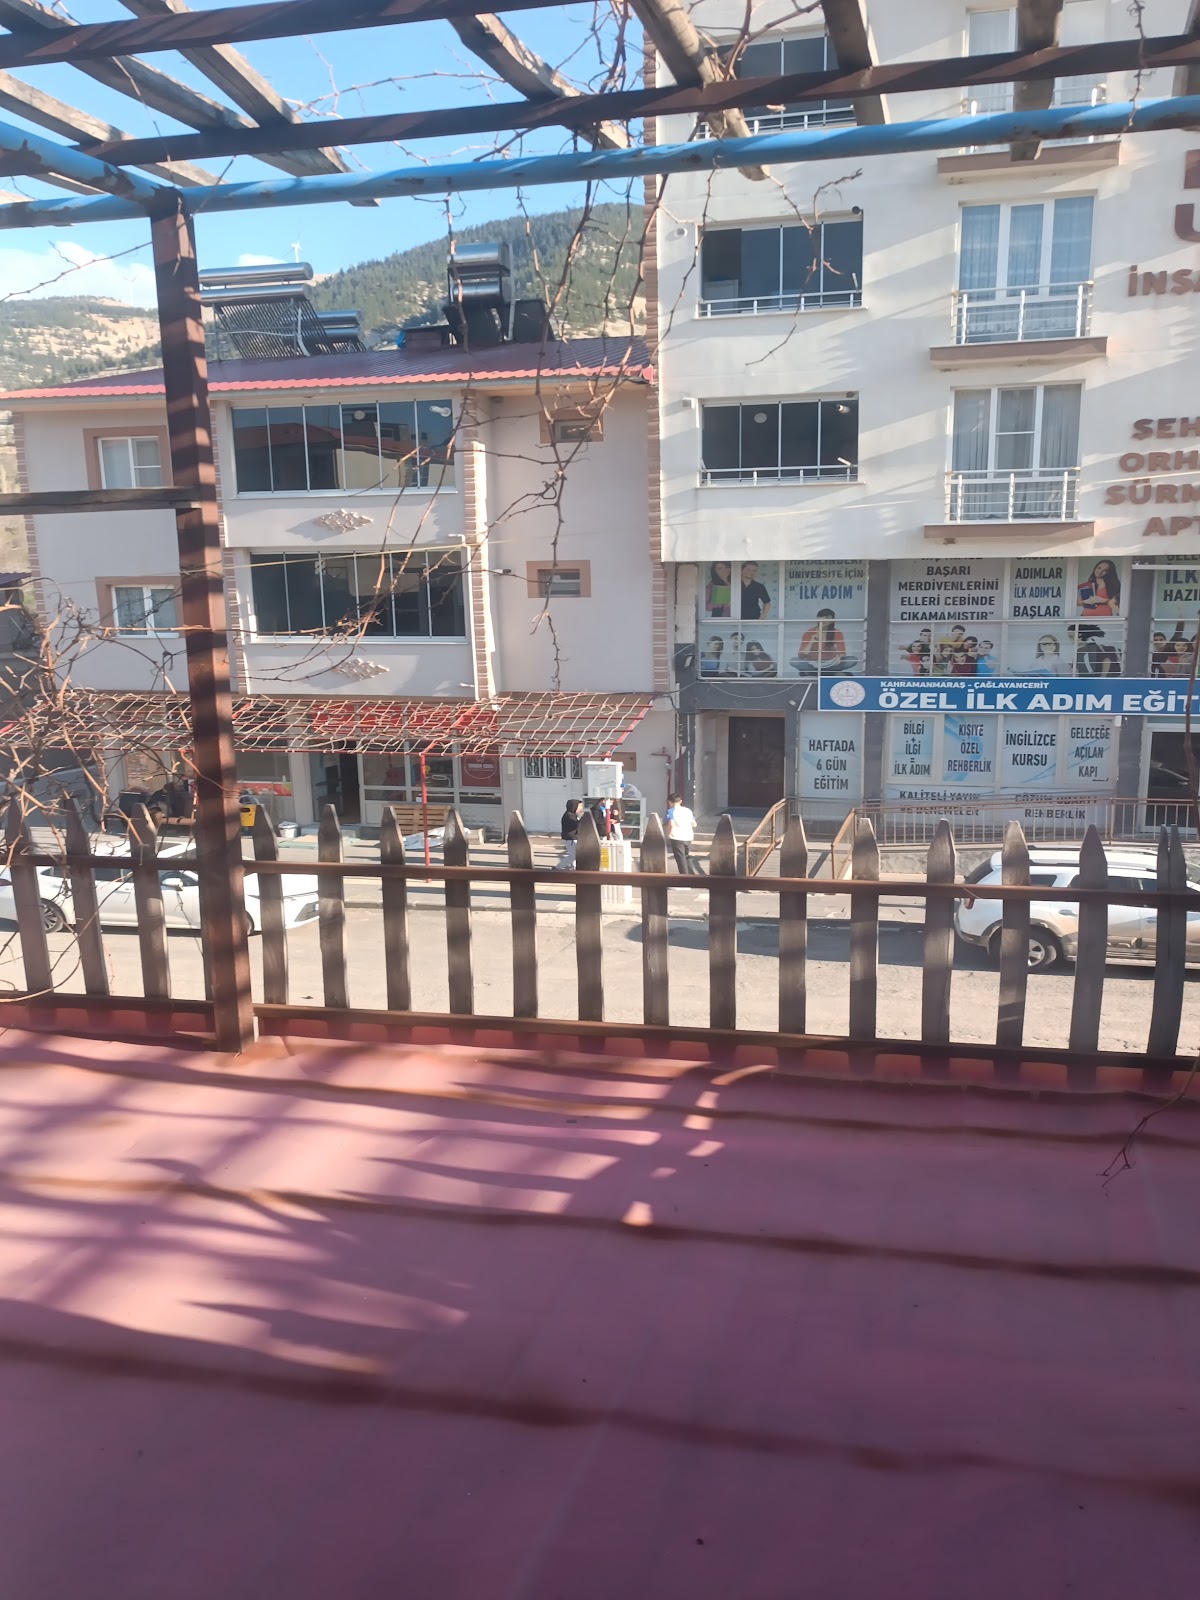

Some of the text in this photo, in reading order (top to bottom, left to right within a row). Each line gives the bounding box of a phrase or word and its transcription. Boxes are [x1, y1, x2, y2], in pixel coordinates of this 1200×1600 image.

[1119, 450, 1200, 472] ORH
[789, 567, 864, 580] ÜNİVERSİTE İÇİN
[926, 566, 971, 577] BAŞARI
[1015, 567, 1063, 579] ADIMLAR
[1165, 562, 1199, 584] İLK
[799, 581, 818, 600] İLK
[821, 585, 853, 600] ADIM
[898, 578, 999, 591] MERDİVENLERİNİ
[1013, 583, 1027, 598] İLK
[900, 594, 996, 606] ELLERİ CEBİNDE
[1163, 589, 1200, 601] HAZI
[1013, 605, 1061, 619] BAŞLAR
[880, 681, 966, 690] KAHRAMANMARAŞ
[974, 680, 1050, 690] ÇAĞLAYANCERİT
[878, 687, 1200, 712] ÖZEL İLK ADIM EĞİT
[903, 720, 925, 735] BİLGİ
[958, 722, 984, 739] KİŞİYE
[1070, 725, 1110, 739] GELECEĞE
[1005, 730, 1056, 746] İNGİLİZCE
[808, 739, 855, 752] HAFTADA
[905, 740, 921, 755] İLGİ
[960, 739, 980, 754] ÖZEL
[1012, 753, 1048, 766] KURSU
[1074, 747, 1104, 760] AÇILAN
[816, 756, 847, 771] 6 GÜN
[894, 760, 930, 775] İLK ADIM
[947, 758, 992, 773] REHBERLİK
[1078, 765, 1098, 778] KAPI
[814, 775, 849, 790] EĞİTİM
[1024, 808, 1086, 819] REHBERLİK
